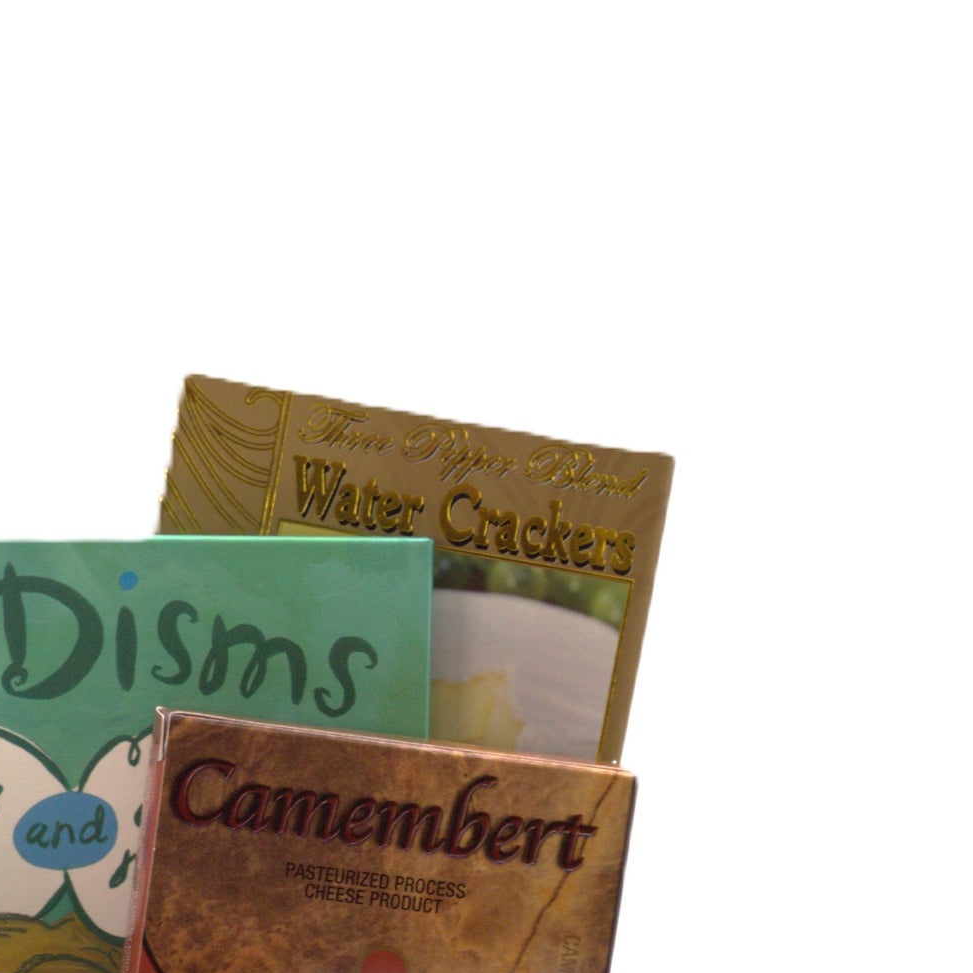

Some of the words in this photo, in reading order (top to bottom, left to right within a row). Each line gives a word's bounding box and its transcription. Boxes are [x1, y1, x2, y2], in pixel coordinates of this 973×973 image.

[298, 402, 395, 454] Three
[526, 444, 649, 499] Blend
[294, 455, 425, 532] Water
[439, 483, 636, 574] Crackers
[27, 804, 108, 848] and
[170, 758, 599, 874] Camembert
[285, 862, 390, 891] PASTEURIZED
[395, 875, 467, 899] PROCESS
[304, 882, 365, 906] CHEESE
[369, 890, 443, 915] PRODUCT
